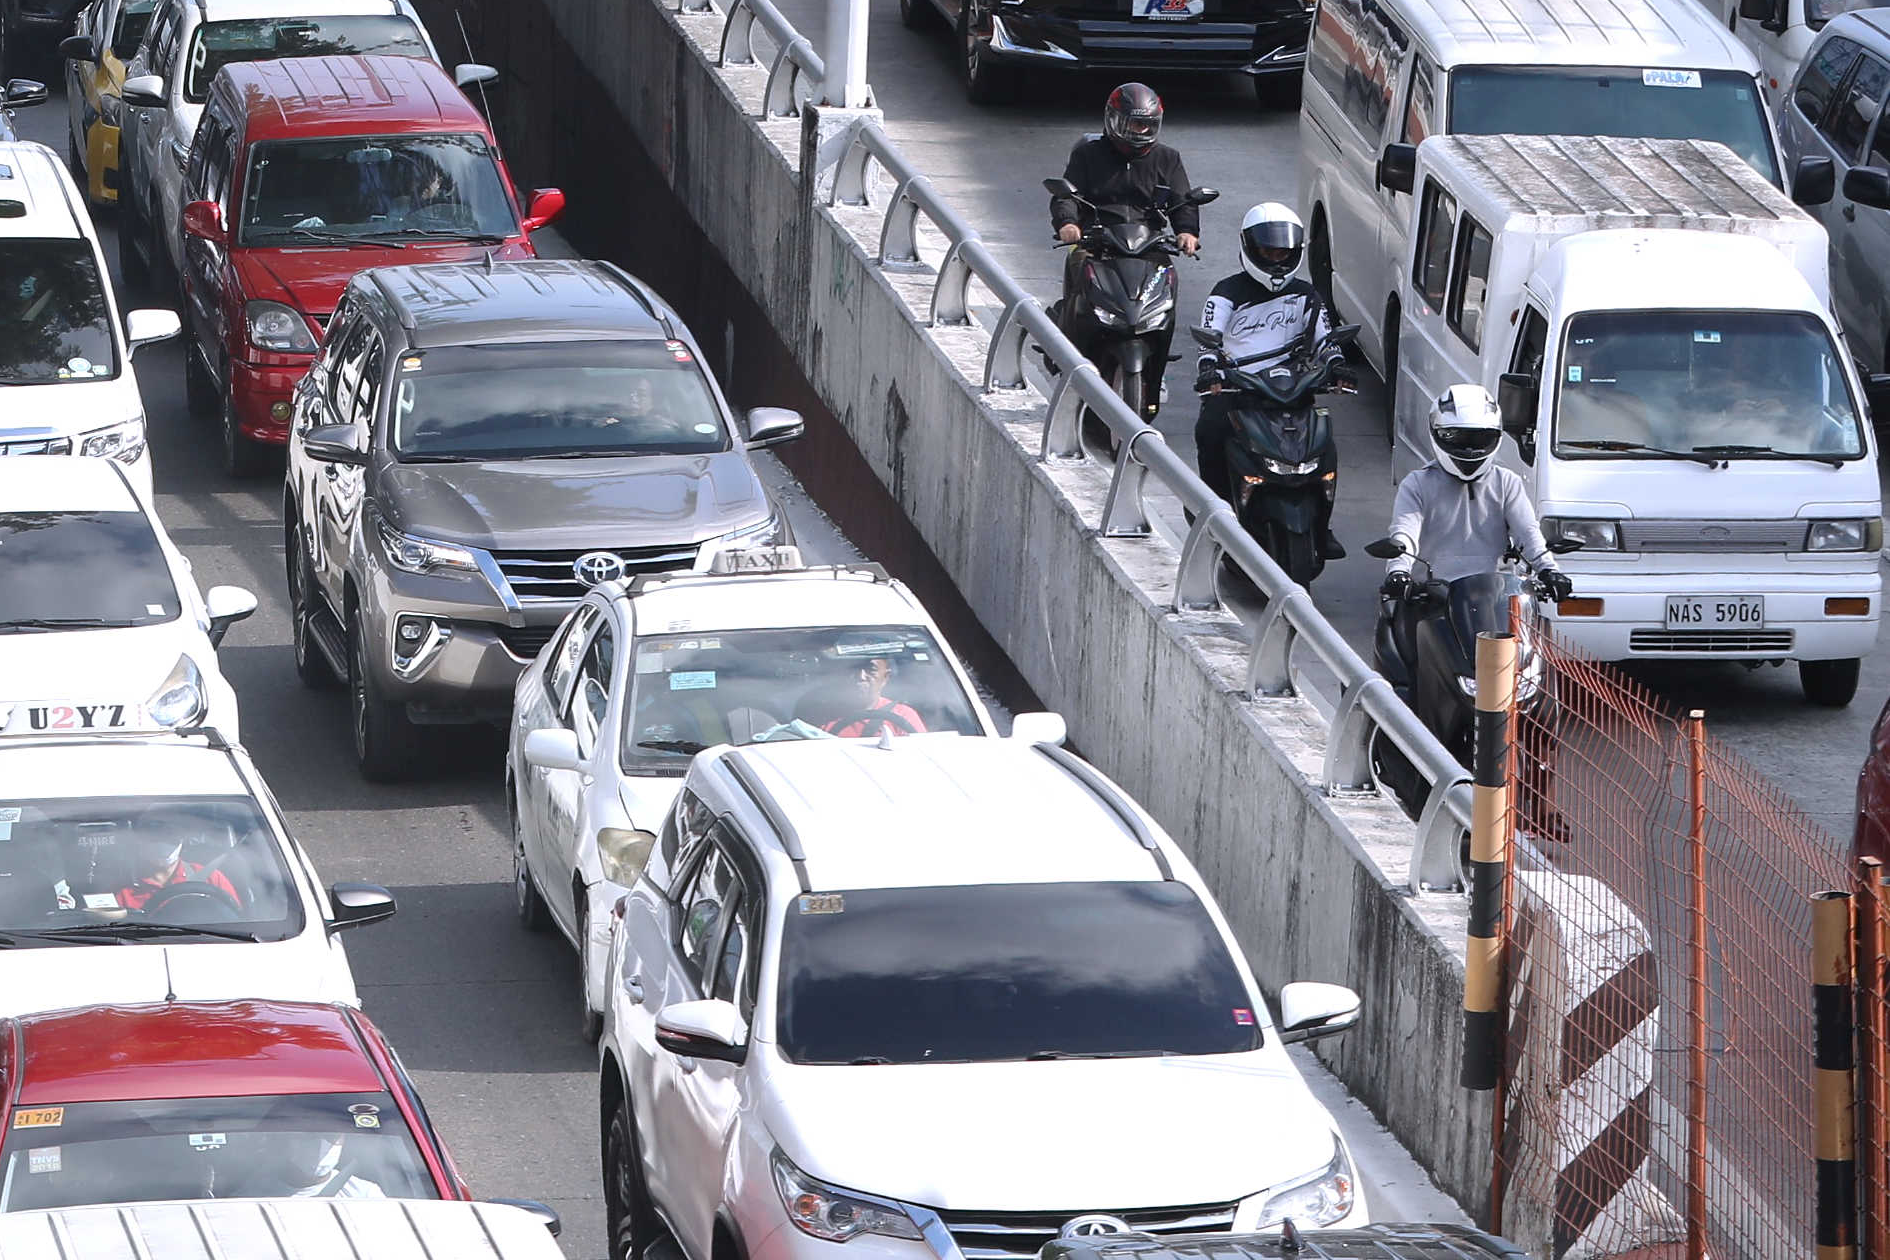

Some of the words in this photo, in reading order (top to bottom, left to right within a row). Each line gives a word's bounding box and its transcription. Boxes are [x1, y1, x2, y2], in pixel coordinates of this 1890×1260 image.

[1202, 300, 1215, 328] PEED
[1669, 604, 1703, 623] NAS
[1716, 603, 1761, 623] 5906
